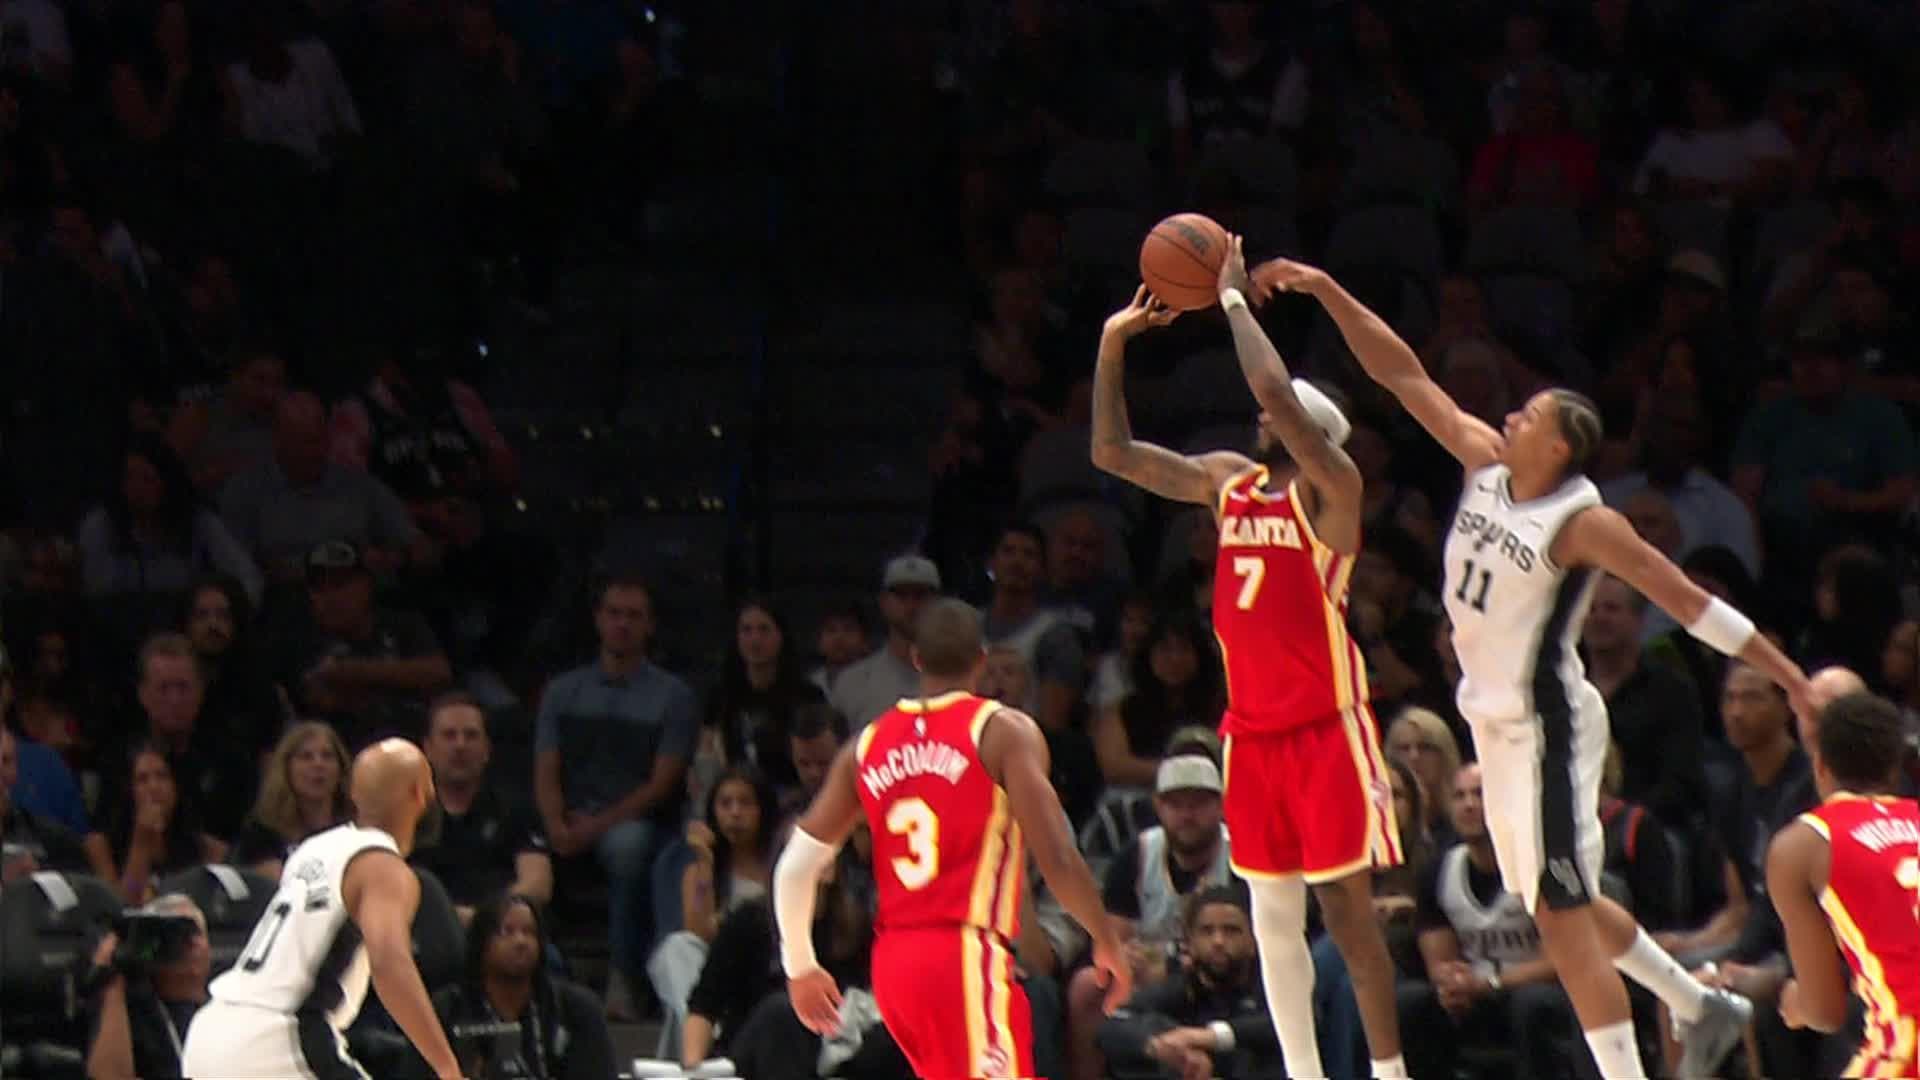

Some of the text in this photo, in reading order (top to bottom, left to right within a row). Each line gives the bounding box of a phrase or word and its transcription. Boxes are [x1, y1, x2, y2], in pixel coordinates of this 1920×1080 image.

[1219, 515, 1303, 551] LANTA
[1457, 510, 1536, 573] SPURS
[1233, 556, 1266, 610] 7
[1456, 558, 1492, 614] 11
[886, 797, 939, 892] 3
